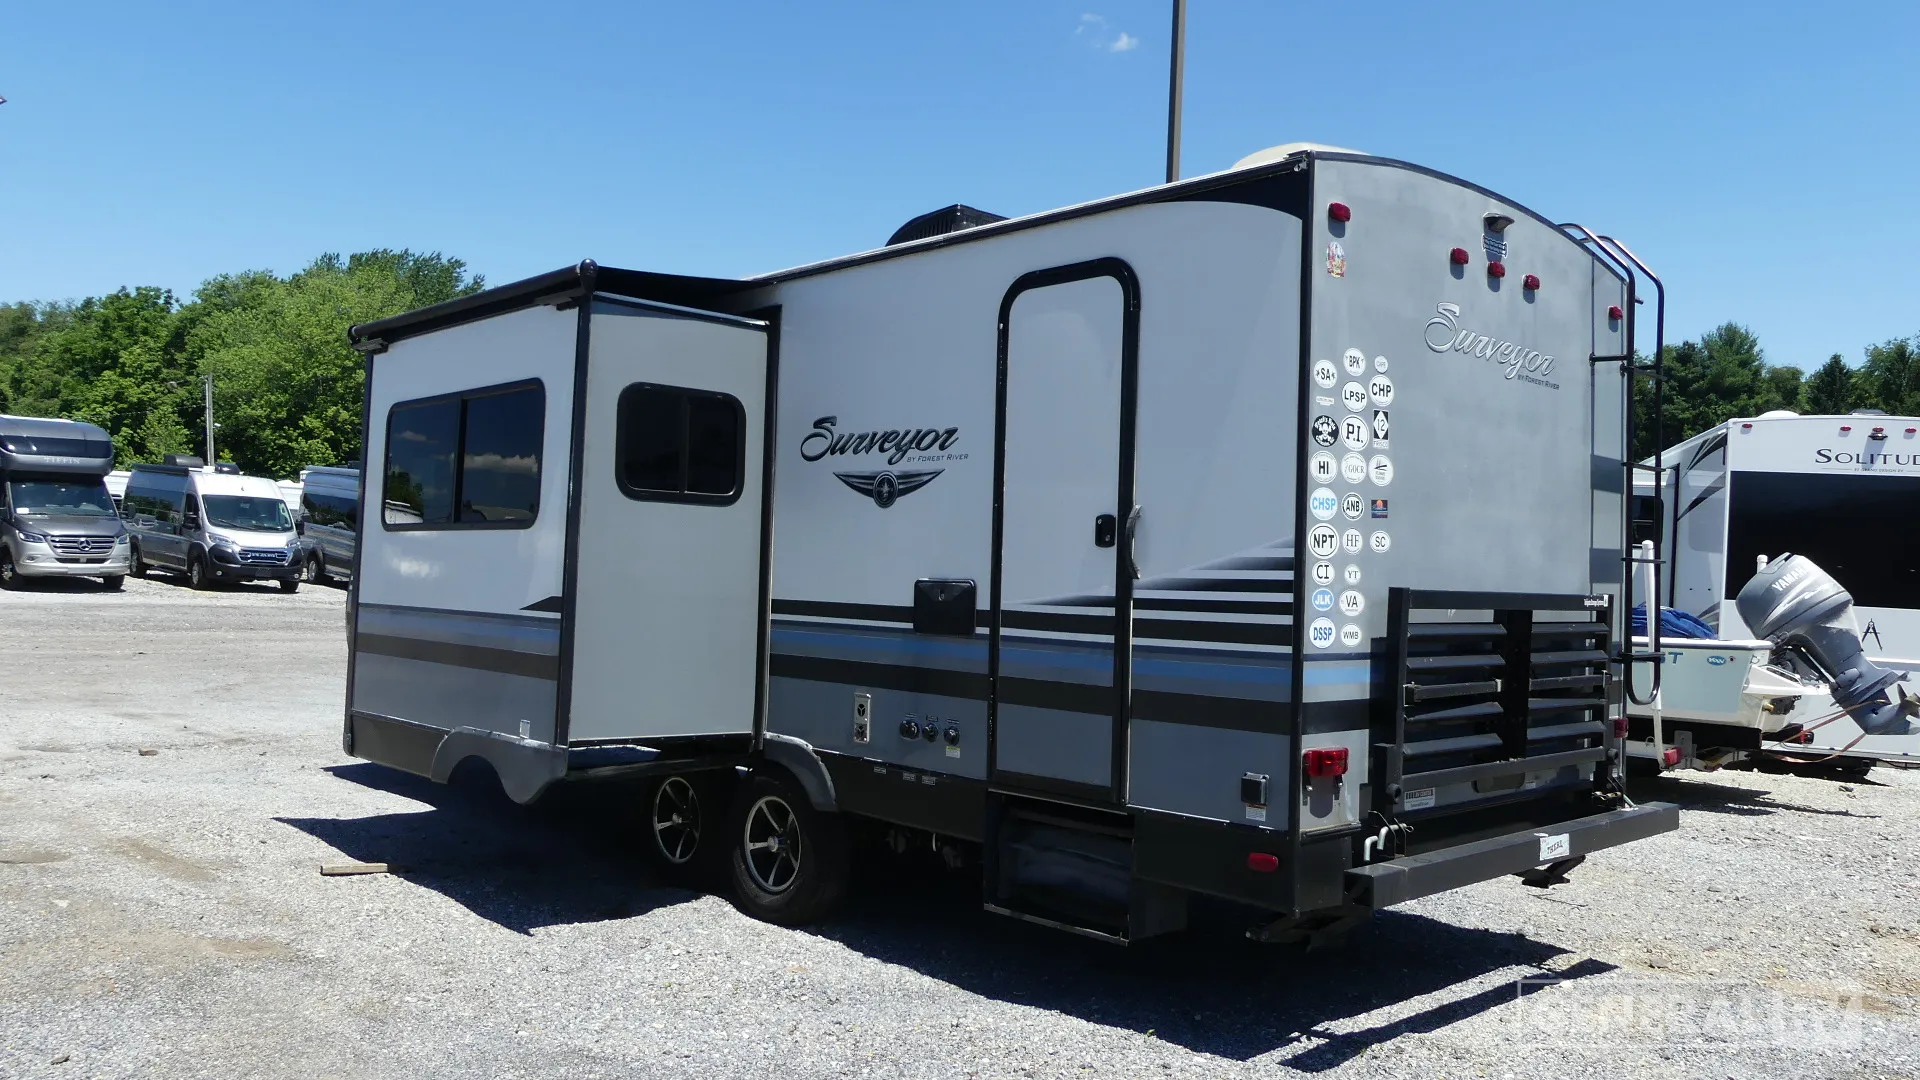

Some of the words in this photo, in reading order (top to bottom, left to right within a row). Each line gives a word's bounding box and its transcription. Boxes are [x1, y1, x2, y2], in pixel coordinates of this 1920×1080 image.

[1424, 301, 1556, 380] Surveyor
[1320, 367, 1331, 381] SA
[1344, 389, 1366, 403] LPSP
[1371, 382, 1392, 398] CHP
[1377, 418, 1385, 432] 12
[800, 415, 960, 466] Surveyor
[44, 456, 80, 465] TIFFIN
[946, 453, 969, 461] RIVER
[1318, 460, 1329, 475] HI
[1312, 496, 1336, 511] CHSP
[1346, 499, 1360, 512] ANB
[1313, 533, 1335, 549] NPT
[1346, 533, 1360, 547] HF
[1375, 536, 1386, 548] SC
[1316, 564, 1330, 579] CI
[1347, 570, 1359, 579] YT
[1771, 565, 1807, 592] YAMAH
[1315, 594, 1331, 605] JLK
[1346, 595, 1359, 608] VA
[1313, 626, 1333, 641] DSSP
